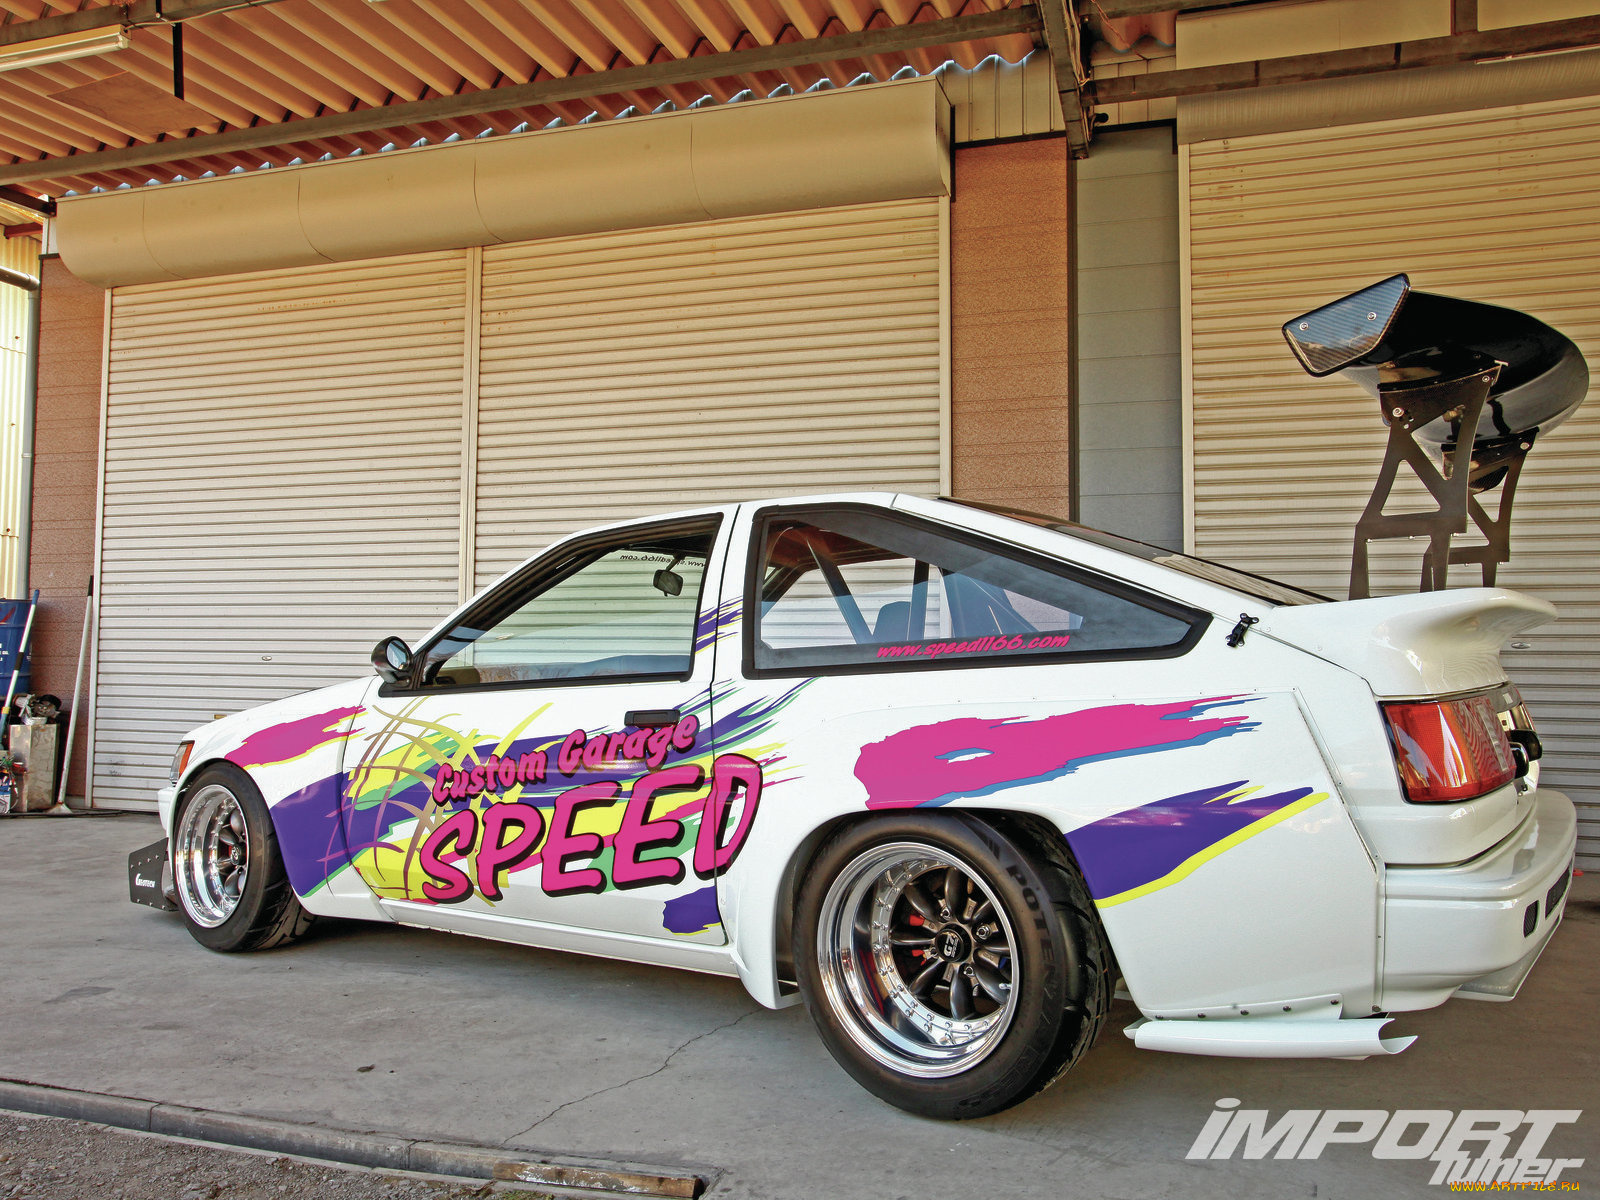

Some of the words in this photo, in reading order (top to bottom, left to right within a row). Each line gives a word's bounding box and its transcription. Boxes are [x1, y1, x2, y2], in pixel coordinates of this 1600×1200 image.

[432, 751, 548, 807] Custom
[557, 714, 700, 778] Garage
[419, 753, 763, 905] SPEED
